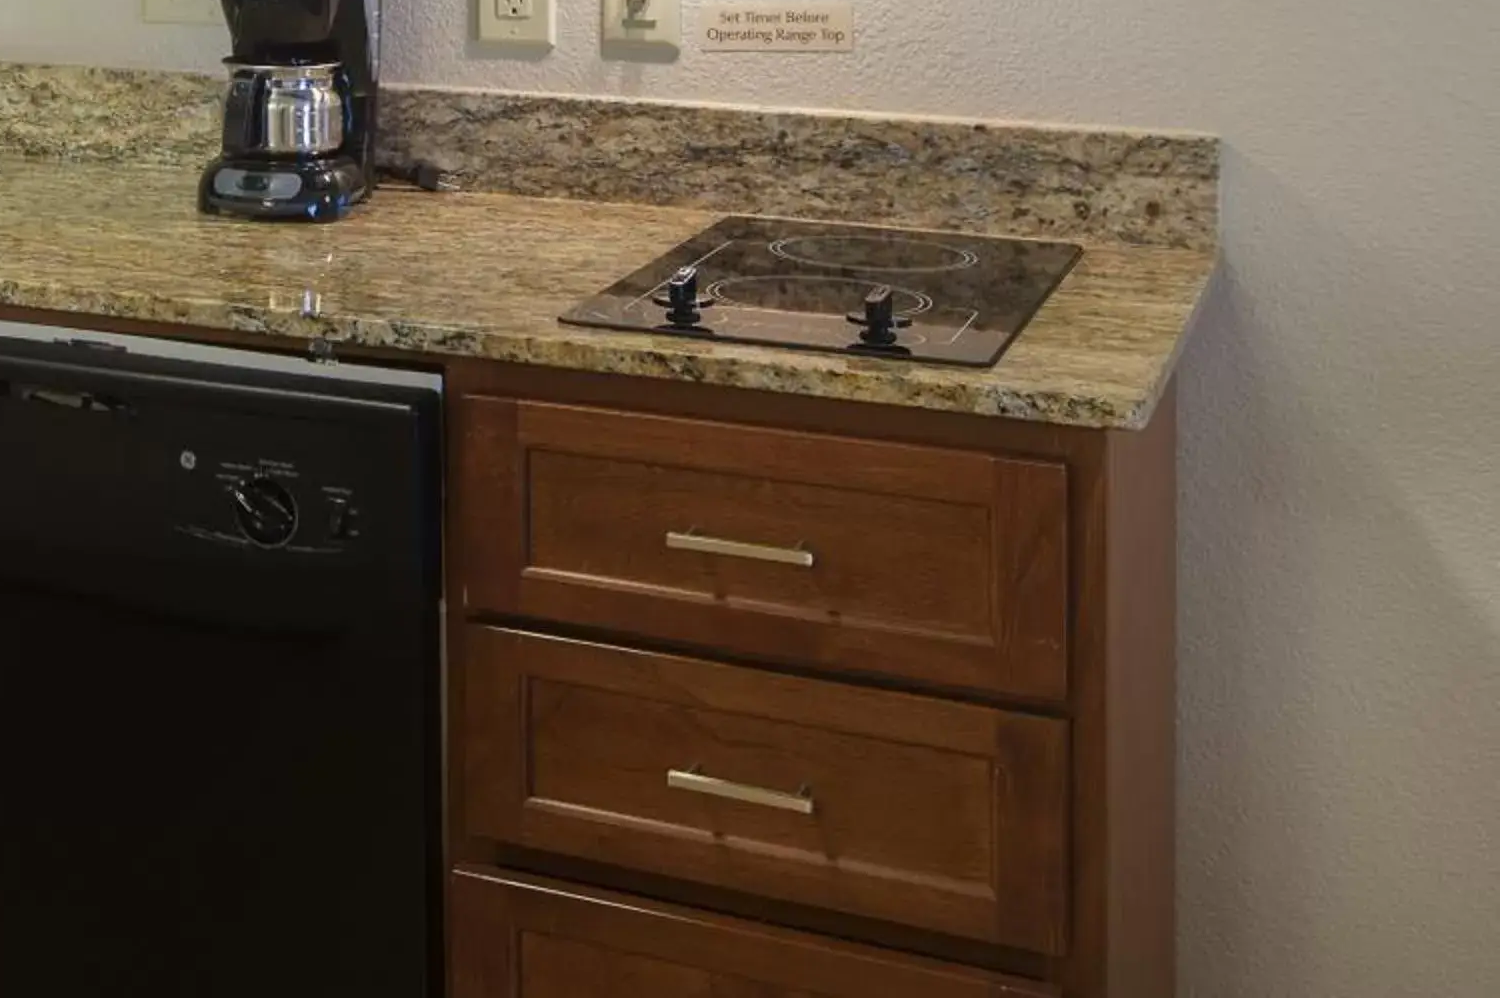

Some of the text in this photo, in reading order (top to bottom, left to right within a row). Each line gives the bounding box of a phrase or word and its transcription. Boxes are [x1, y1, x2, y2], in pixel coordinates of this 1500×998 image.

[719, 10, 830, 24] Set Timer Before
[706, 27, 845, 44] Operating Range Top
